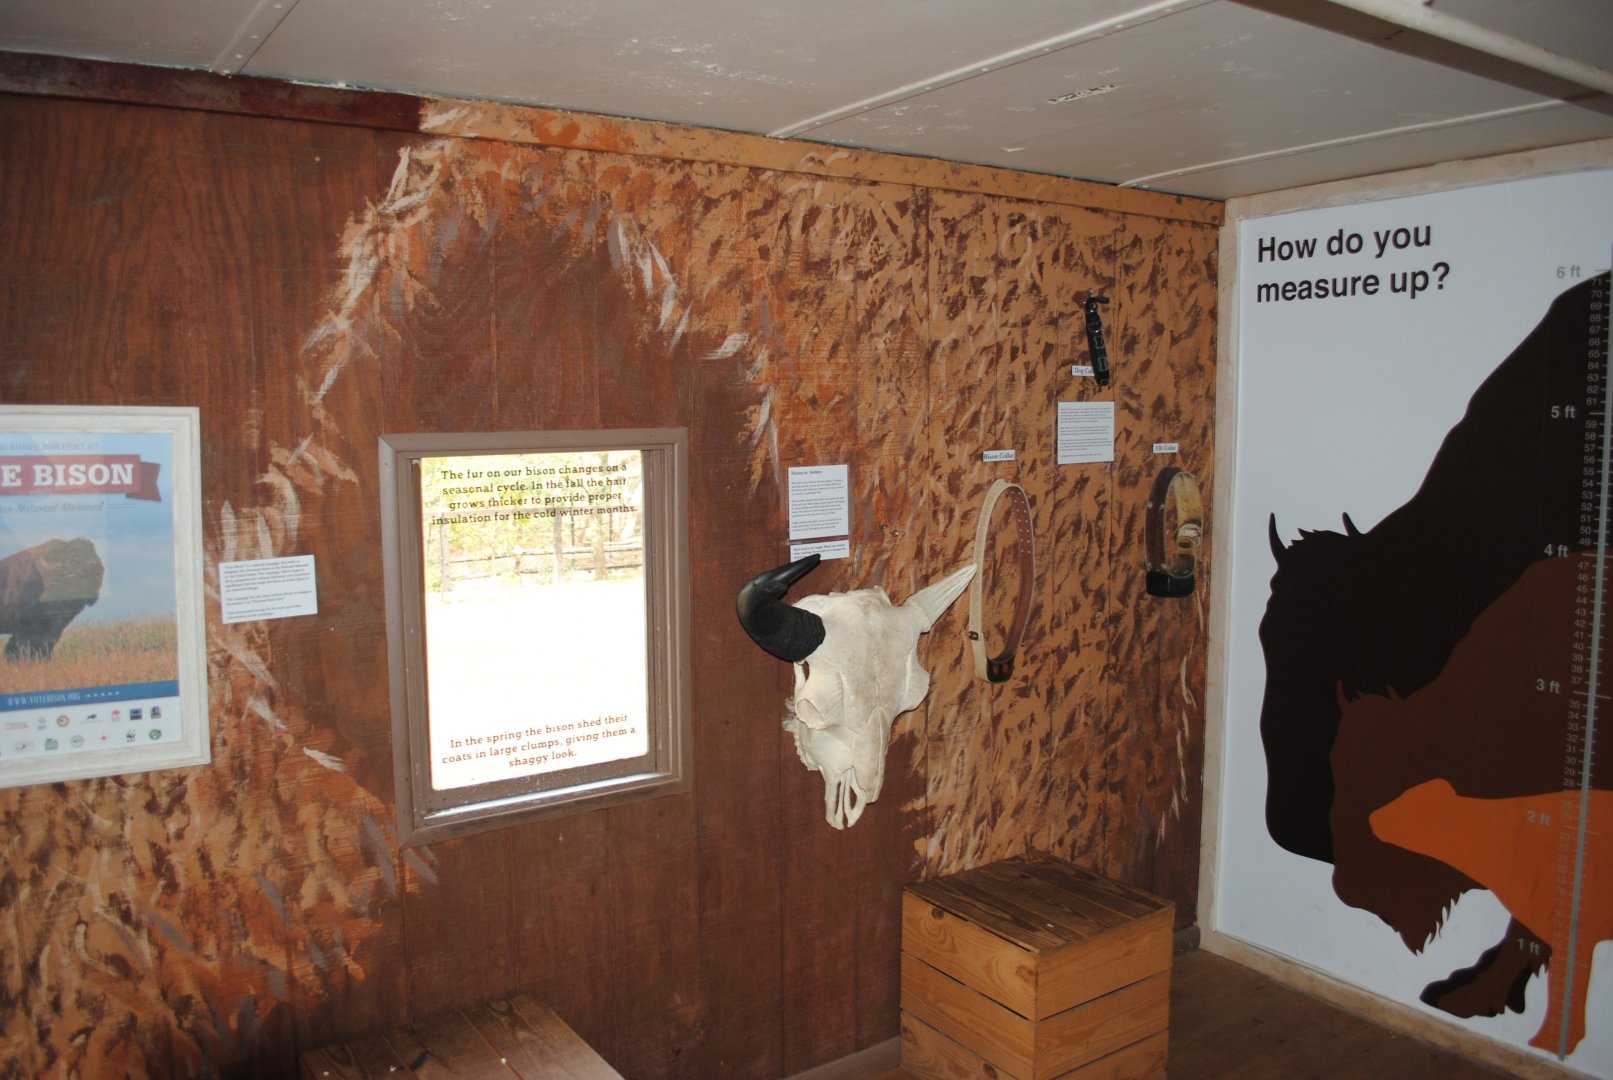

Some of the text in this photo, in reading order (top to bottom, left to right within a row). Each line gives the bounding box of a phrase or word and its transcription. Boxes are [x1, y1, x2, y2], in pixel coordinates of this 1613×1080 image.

[1258, 225, 1431, 262] How do you
[1556, 265, 1581, 279] 6 ft
[1257, 262, 1450, 302] measure up?
[1591, 278, 1602, 286] 71
[1588, 350, 1599, 358] 65
[1551, 405, 1575, 418] 5 ft
[33, 464, 134, 486] BISON
[442, 470, 463, 480] The
[466, 469, 482, 478] fur
[526, 465, 555, 476] bison
[559, 464, 603, 475] changes
[442, 484, 493, 495] seasonal
[497, 482, 529, 493] cycle.
[532, 482, 543, 490] In
[546, 480, 563, 488] the
[566, 478, 584, 488] fall
[587, 478, 603, 487] the
[450, 501, 485, 511] grows
[488, 497, 527, 507] thicker
[545, 492, 585, 504] provide
[589, 492, 622, 504] proper
[432, 504, 638, 525] insulation for the cold winter months.
[1544, 544, 1568, 558] 4 ft
[1577, 573, 1588, 581] 46
[1574, 619, 1585, 628] 42
[1571, 665, 1582, 673] 38
[1536, 679, 1560, 694] 3 ft
[1570, 676, 1581, 684] 37
[1569, 700, 1580, 708] 35
[1568, 711, 1579, 720] 34
[450, 714, 628, 748] In the spring the bison shed their
[1568, 722, 1578, 731] 33
[1567, 734, 1578, 742] 32
[442, 753, 472, 764] coats
[476, 749, 486, 758] in
[490, 746, 518, 757] large
[521, 739, 563, 752] clumps,
[566, 732, 598, 745] giving
[602, 728, 627, 738] them
[1566, 745, 1575, 753] 31
[509, 749, 577, 767] shaggy look.
[1565, 756, 1576, 764] 30
[1528, 810, 1536, 822] 2
[1540, 812, 1551, 826] ft
[1518, 938, 1523, 950] 1
[1530, 942, 1540, 954] ft
